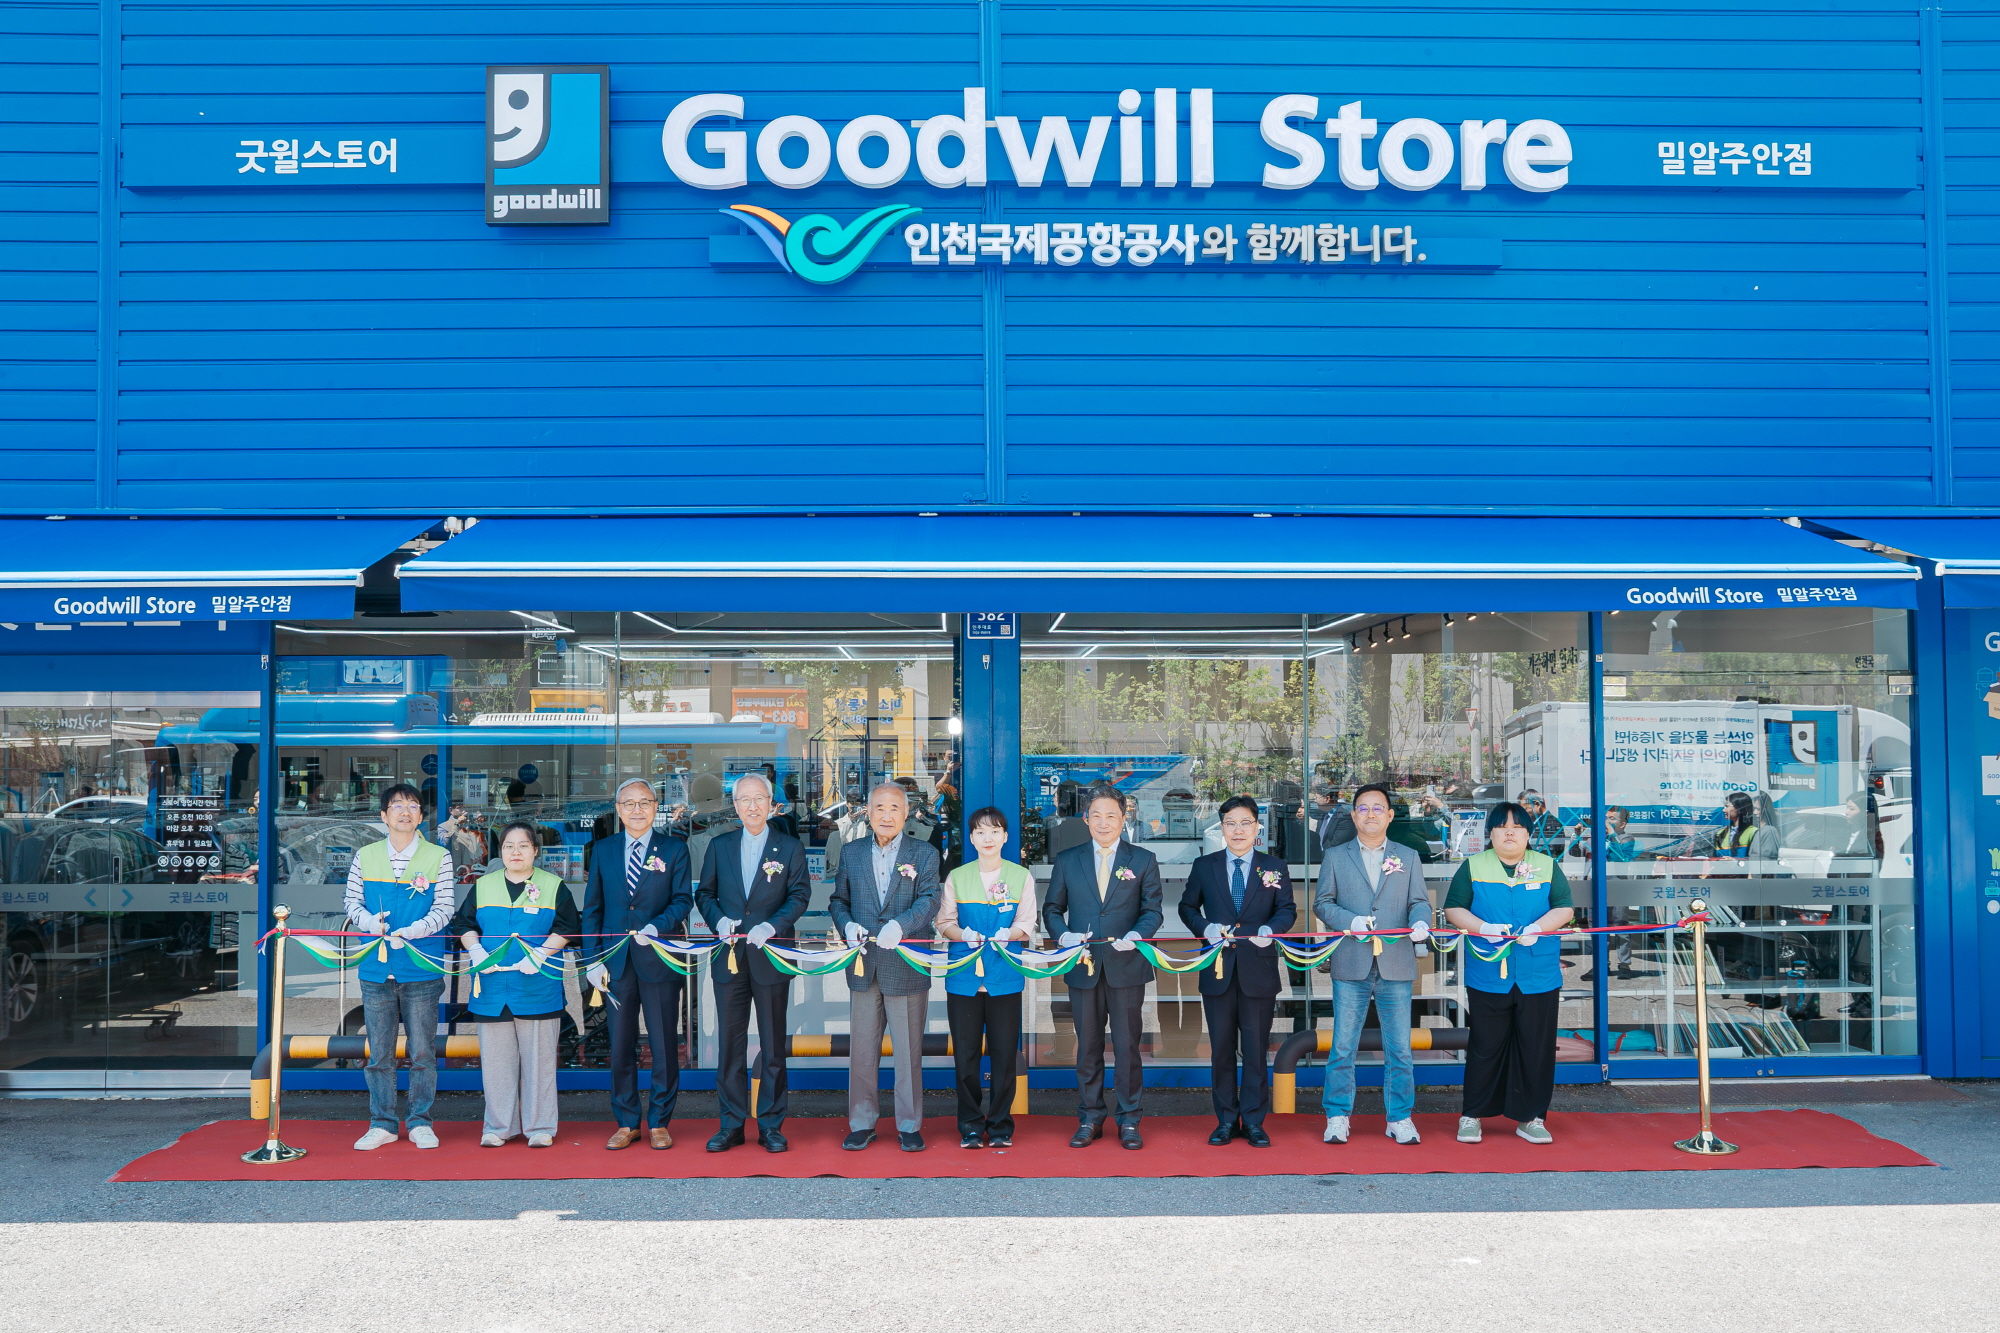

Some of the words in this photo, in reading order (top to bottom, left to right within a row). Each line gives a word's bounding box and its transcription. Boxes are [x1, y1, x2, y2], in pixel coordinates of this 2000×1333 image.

[662, 87, 1214, 190] Goodwill
[1260, 93, 1573, 193] Store
[235, 138, 397, 174] 굿윌스토어
[1658, 141, 1812, 176] 밀알주안점
[494, 188, 601, 219] goodwill
[1246, 222, 1427, 265] 함께합니다.
[1626, 587, 1711, 604] Goodwill
[1715, 587, 1764, 604] Store
[1776, 586, 1858, 602] 밀알주안점
[54, 595, 140, 615] Goodwill
[145, 596, 196, 615] Store
[211, 595, 292, 614] 밀알주안점
[169, 891, 229, 904] 굿윌스토어
[1652, 886, 1711, 899] 굿윌스토어
[1811, 885, 1870, 898] 굿윌스토어
